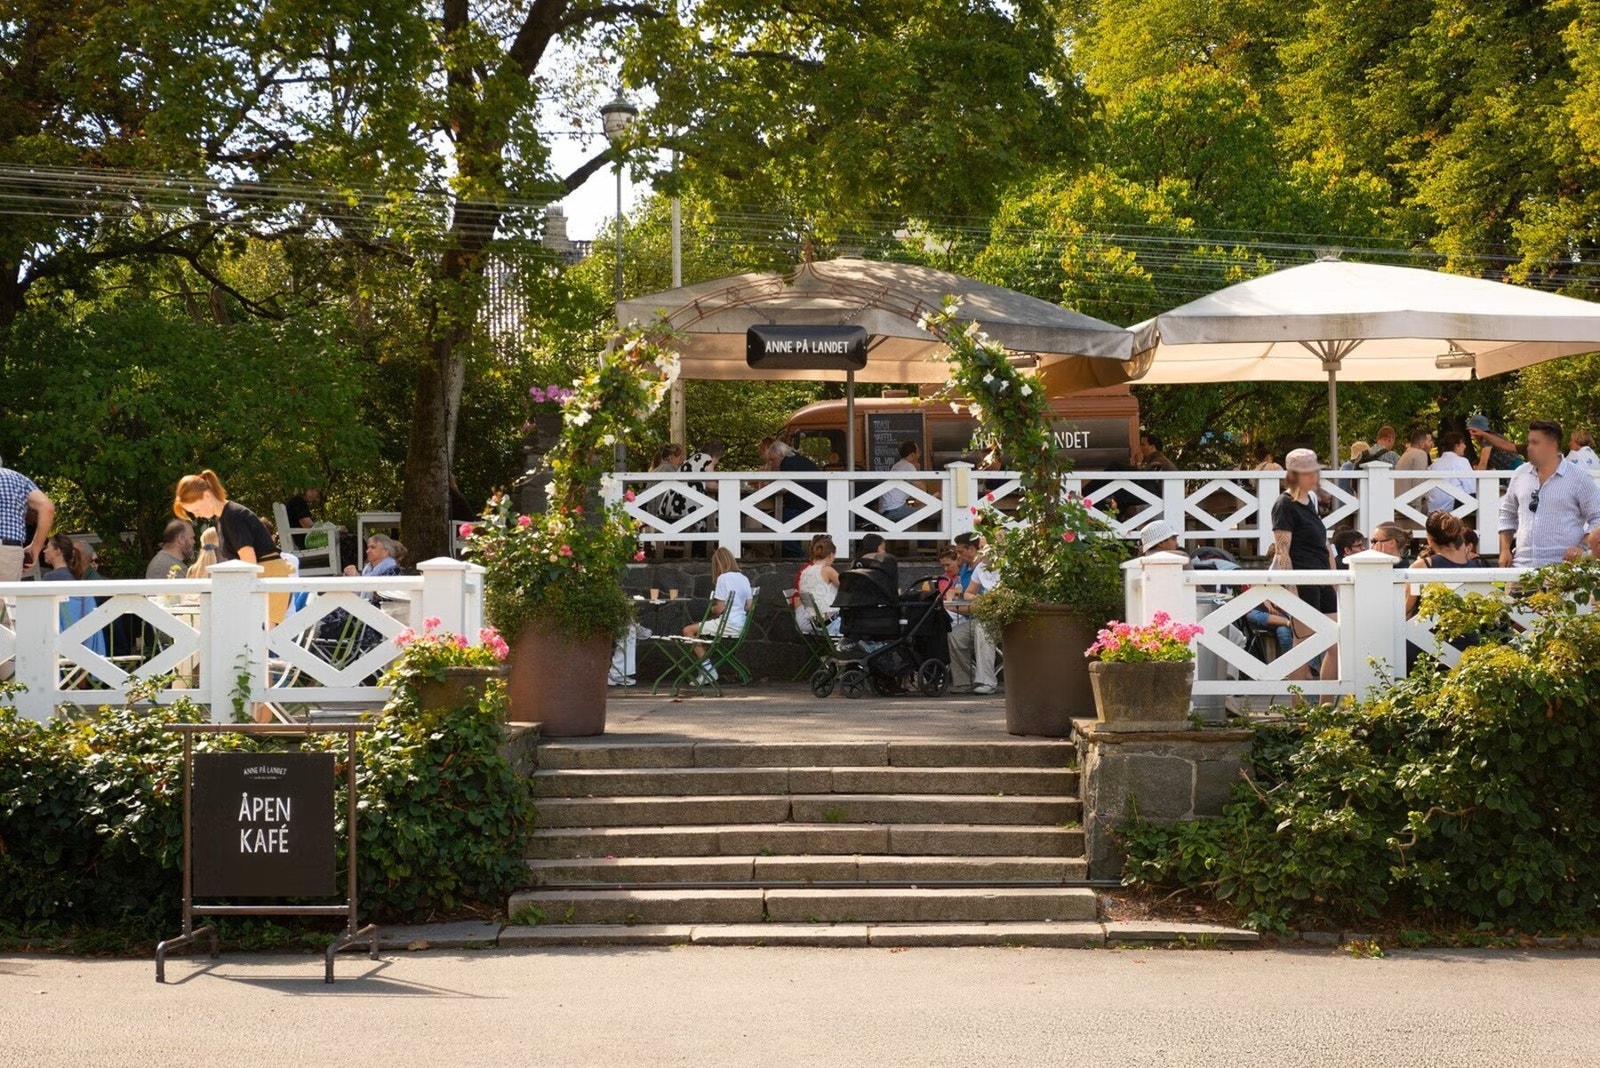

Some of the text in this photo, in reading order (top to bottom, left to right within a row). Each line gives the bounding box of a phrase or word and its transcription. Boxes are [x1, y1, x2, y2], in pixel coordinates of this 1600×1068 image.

[765, 338, 849, 354] ANNE PÅ LANDET
[1054, 431, 1091, 449] NDET
[243, 766, 258, 775] ANNE
[267, 766, 287, 775] LANDET
[238, 792, 291, 822] ÅPEN
[240, 823, 289, 853] KAFÉ
